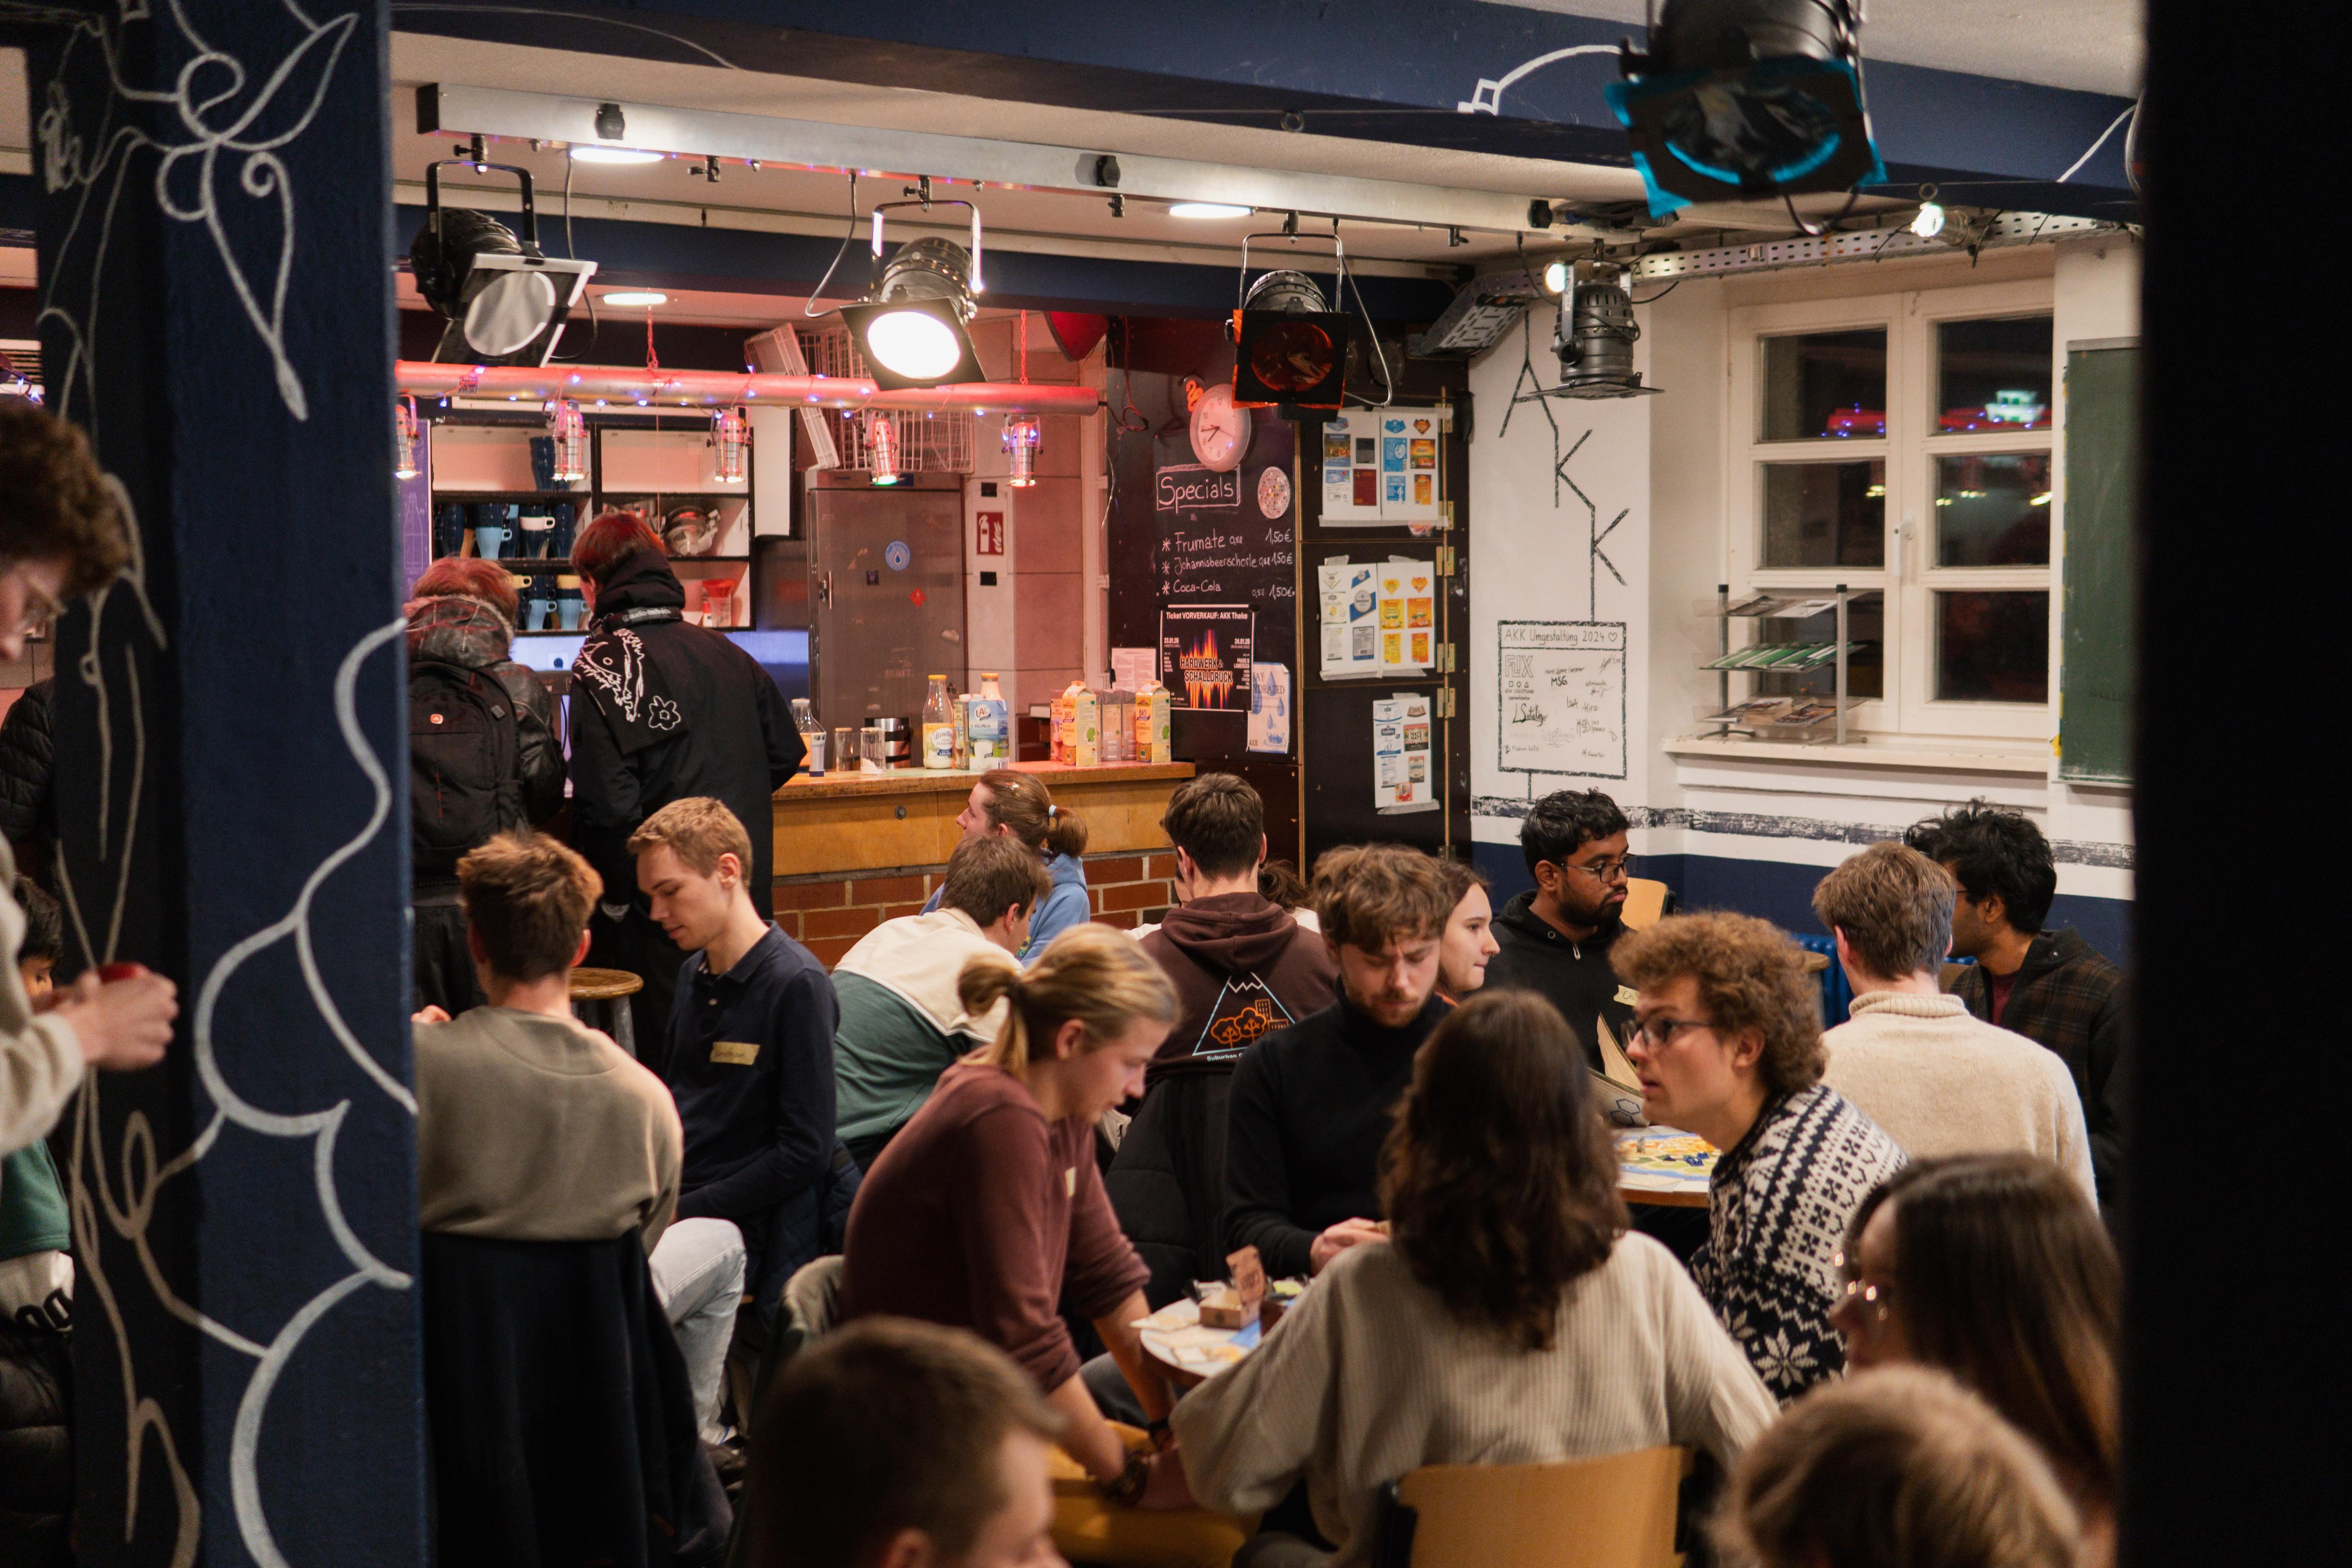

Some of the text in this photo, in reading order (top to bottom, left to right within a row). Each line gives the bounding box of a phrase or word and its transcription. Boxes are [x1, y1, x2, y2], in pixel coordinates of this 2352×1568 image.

[1159, 476, 1234, 514] Specials
[1175, 528, 1225, 552] Frumate
[1265, 528, 1292, 545] 1,50€
[1174, 556, 1257, 574] Johannisbeerschorle
[1271, 552, 1293, 566] 1,50€
[1173, 580, 1221, 593] Coca-Cola
[1269, 584, 1292, 599] 1,50€
[1504, 628, 1604, 646] AKK Umgestaltung 2024
[1180, 658, 1217, 668] HARDWERK
[1218, 659, 1223, 668] &
[1185, 671, 1233, 683] SCHALLDRUCK
[1551, 675, 1568, 687] MSG
[1253, 685, 1284, 695] YDRATED
[976, 705, 990, 717] LAC
